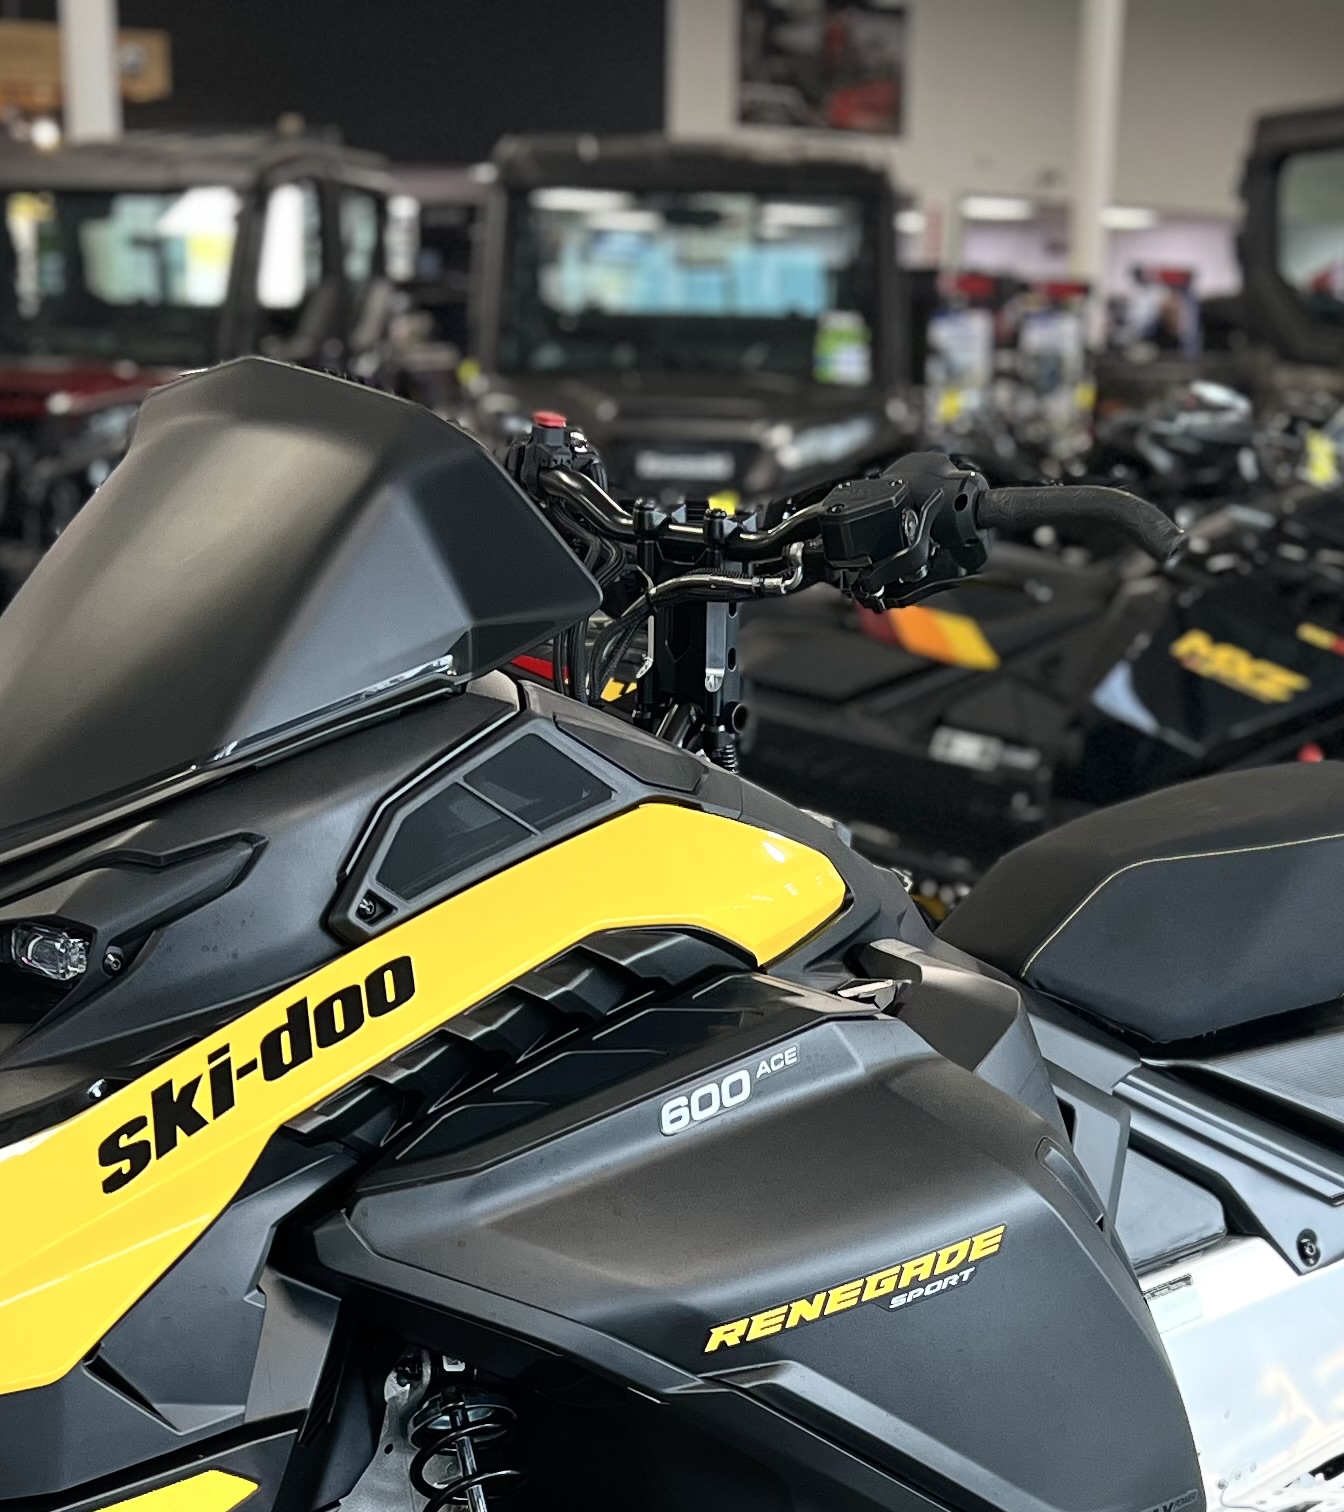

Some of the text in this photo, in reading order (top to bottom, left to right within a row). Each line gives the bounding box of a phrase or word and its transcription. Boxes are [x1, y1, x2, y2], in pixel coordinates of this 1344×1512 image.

[97, 955, 416, 1195] ski-doo
[661, 1046, 798, 1135] 600 ACE
[704, 1224, 1006, 1353] RENEGADE
[888, 1266, 976, 1310] SPORT
